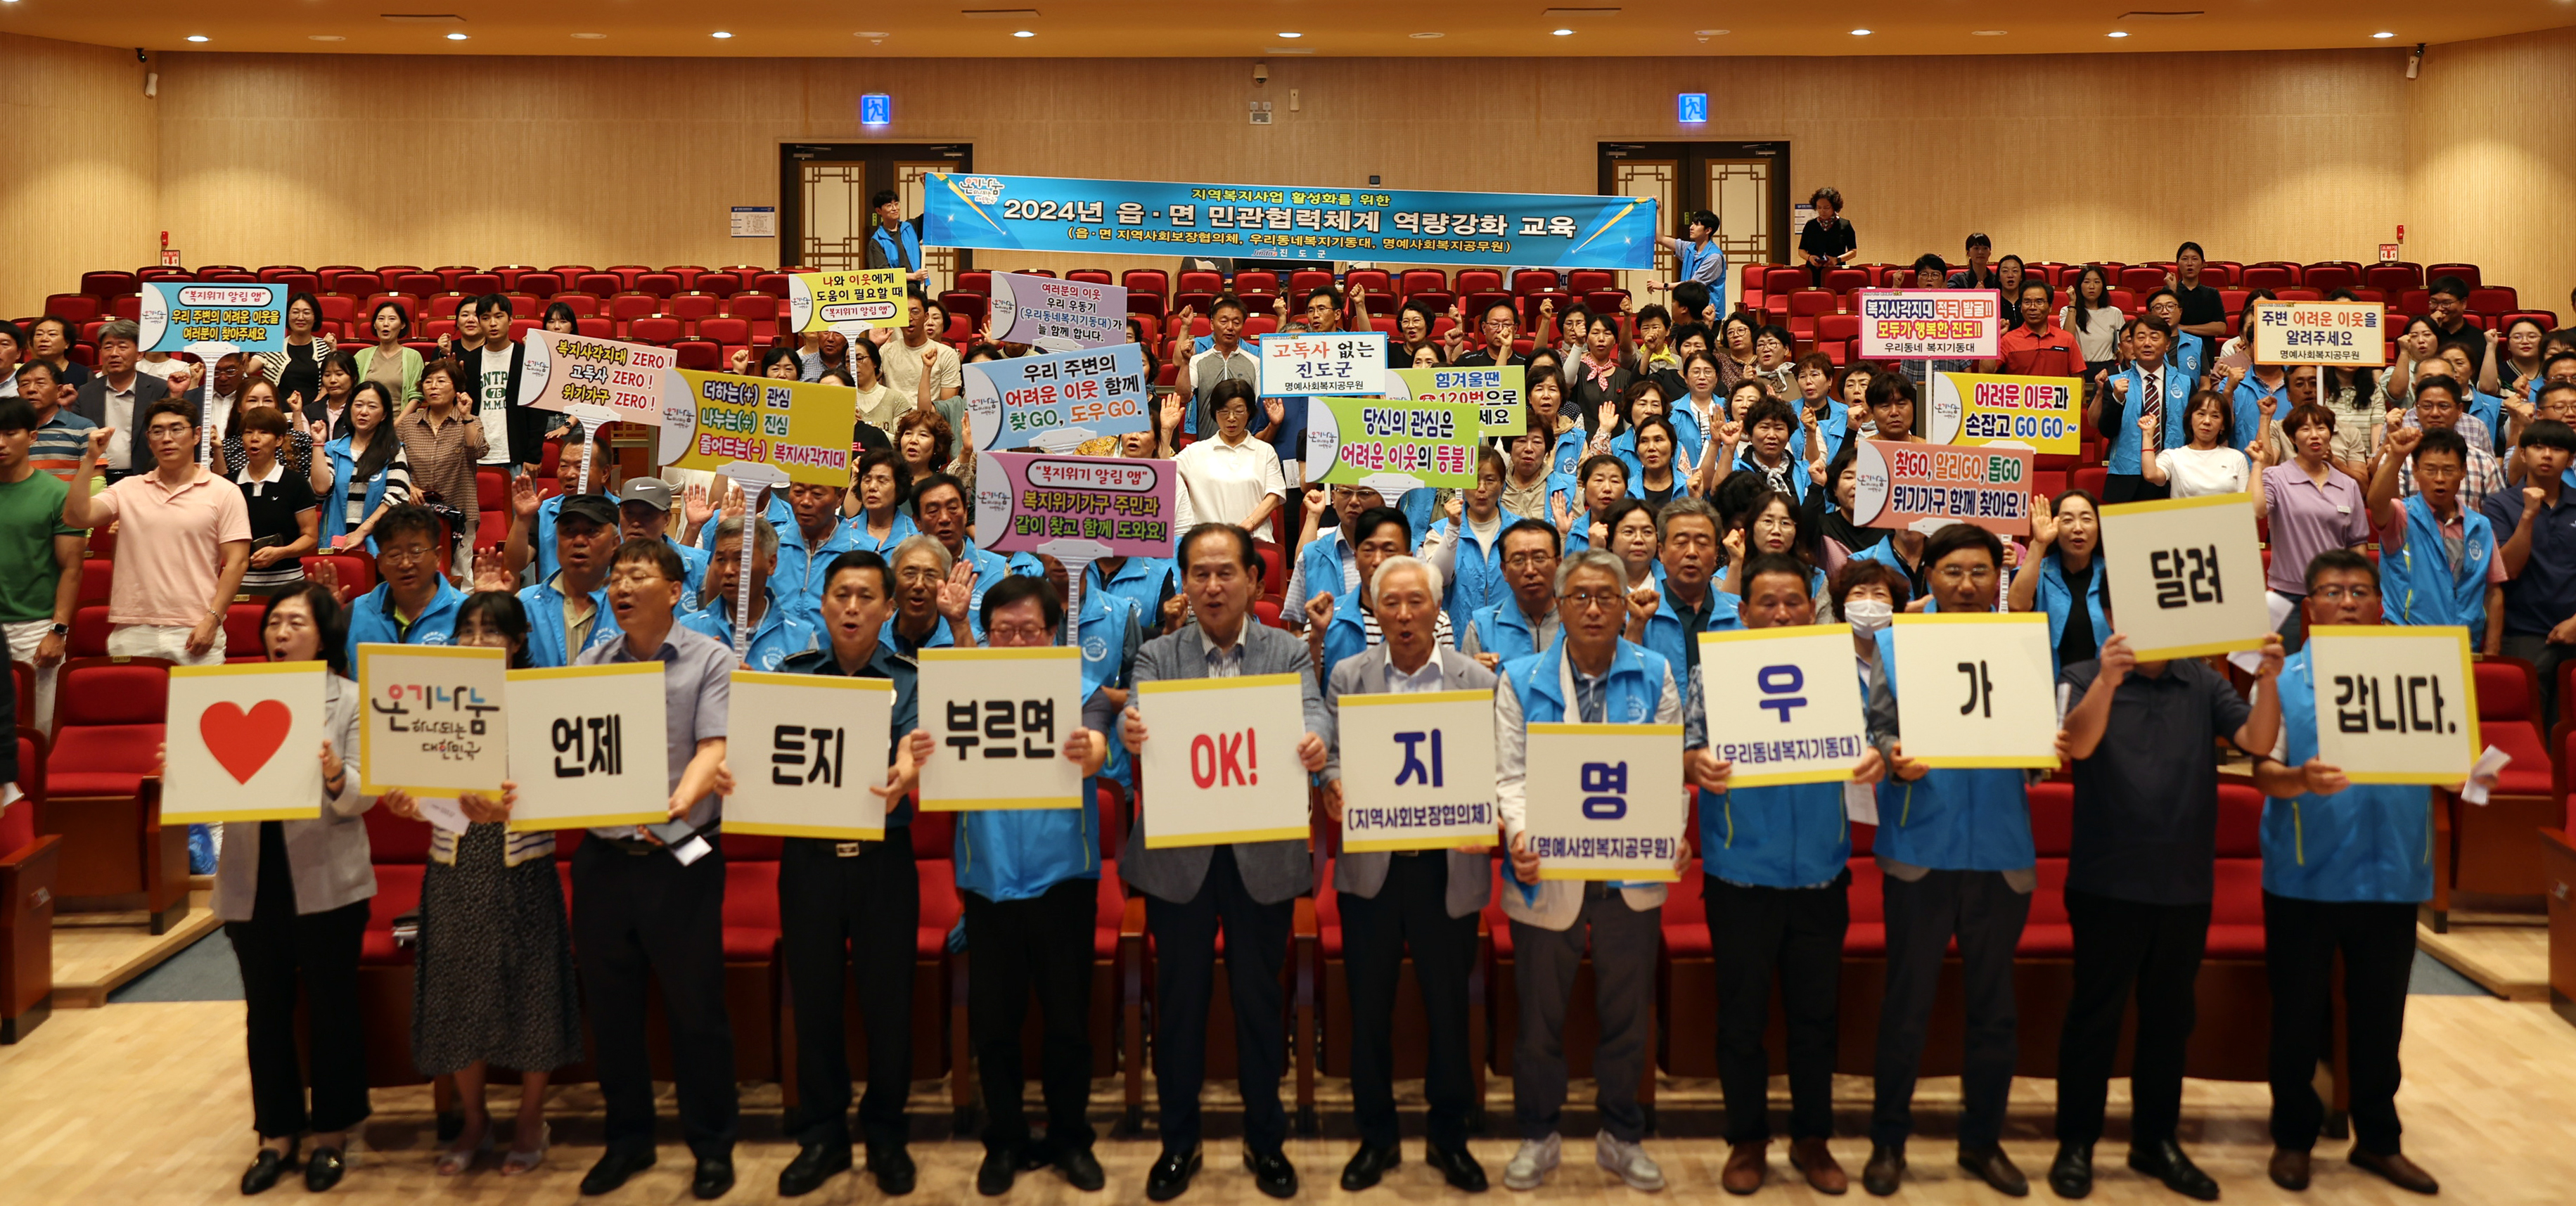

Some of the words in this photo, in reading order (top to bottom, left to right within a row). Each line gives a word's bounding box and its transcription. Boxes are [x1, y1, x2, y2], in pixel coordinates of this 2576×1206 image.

[960, 179, 1004, 195] 온기나눔
[1192, 188, 1283, 203] 지역복지사업
[1291, 191, 1352, 205] 활성화를
[1359, 194, 1391, 207] 위한
[1003, 199, 1103, 224] 2024년
[1209, 205, 1380, 233] 민관협력체계
[1393, 212, 1508, 236] 역량강화
[1518, 216, 1577, 238] 교육
[1116, 229, 1243, 245] 지역사회보장협의체,
[1250, 233, 1376, 249] 우리동네복지기동대,
[1383, 238, 1511, 253] 명예사회복지공무원)
[823, 276, 845, 287] 나와
[849, 273, 894, 286] 이웃에게
[1042, 283, 1079, 297] 여러분의
[1082, 288, 1101, 300] 이웃
[816, 290, 849, 302] 도움이
[854, 288, 887, 300] 필요할
[892, 287, 903, 297] 때
[1047, 297, 1065, 309] 우리
[1068, 302, 1096, 313] 우동기
[172, 310, 190, 323] 우리
[193, 309, 220, 324] 주변의
[222, 310, 250, 324] 어려운
[252, 310, 280, 324] 이웃을
[1020, 307, 1122, 331] (우리동네복지기동대)가
[1866, 300, 1934, 318] 복지사각지대
[1936, 300, 1960, 318] 적극
[1961, 300, 1993, 318] 발굴!!
[2262, 311, 2288, 326] 주변
[2293, 312, 2333, 327] 어려운
[2338, 312, 2377, 328] 이웃을
[183, 327, 219, 341] 여러분이
[222, 327, 267, 341] 찾아주세요
[1038, 323, 1046, 335] 늘
[1051, 325, 1069, 338] 함께
[1073, 328, 1104, 342] 합니다.
[1877, 320, 1912, 339] 모두가
[1913, 321, 1949, 340] 행복한
[1950, 321, 1982, 339] 진도!!
[2286, 330, 2353, 346] 알려주세요
[556, 339, 627, 366] 복지사각지대
[1272, 341, 1331, 359] 고독사
[1338, 340, 1375, 359] 없는
[1885, 343, 1923, 353] 우리동네
[1927, 342, 1975, 352] 복지기동대
[2280, 350, 2360, 360] 명예사회복지공무원
[570, 365, 608, 384] 고독사
[1023, 361, 1058, 383] 우리
[1064, 354, 1116, 378] 주변의
[1295, 361, 1352, 378] 진도군
[1435, 371, 1501, 388] 힘겨울땐
[490, 389, 501, 398] 76
[562, 383, 610, 405] 위기가구
[703, 380, 760, 407] 더하는(+)
[767, 387, 791, 409] 관심
[1006, 385, 1058, 408] 어려운
[1064, 380, 1098, 401] 이웃
[1104, 374, 1139, 396] 함께
[1285, 380, 1364, 391] 명예사회복지공무원
[1975, 383, 2020, 407] 어려운
[2024, 385, 2068, 410] 이웃과
[764, 415, 788, 435] 진심
[1363, 408, 1406, 436] 당신의
[1410, 410, 1454, 439] 관심은
[1966, 413, 2011, 437] 손잡고
[2015, 416, 2037, 437] GO
[2042, 417, 2063, 438] GO
[774, 443, 845, 469] 복지사각지대
[1341, 442, 1385, 470] 어려운
[1388, 444, 1431, 472] 이웃의
[1895, 450, 1931, 480] 찾GO,
[1935, 453, 1984, 483] 알리GO,
[1988, 456, 2021, 482] 돕GO
[1036, 466, 1090, 482] "복지위기
[1095, 469, 1122, 485] 알림
[1127, 470, 1148, 485] 앱"
[1023, 490, 1110, 515] 복지위기가구
[1115, 495, 1159, 516] 주민과
[1893, 486, 1946, 514] 위기가구
[1949, 488, 1976, 515] 함께
[1015, 515, 1044, 535] 같이
[1049, 516, 1078, 536] 찾고
[1083, 518, 1113, 539] 함께
[1117, 521, 1167, 541] 도와요!
[2149, 544, 2224, 609] 달려
[1757, 664, 1807, 722] 우
[1958, 660, 1994, 718] 가
[372, 684, 500, 735] 온기나눔
[2334, 674, 2456, 734] 갑니다.
[411, 718, 466, 739] 하나되는
[946, 698, 1055, 759] 부르면
[422, 739, 482, 760] 대한민국
[552, 714, 622, 778] 언제
[772, 724, 844, 788] 든지
[1191, 727, 1258, 789] OK!
[1716, 735, 1861, 765] (우리동네복지기동대)
[1393, 729, 1443, 788] 지
[1581, 761, 1627, 820] 명
[1348, 802, 1492, 830] (지역사회보장협의체)
[1530, 835, 1675, 862] (명예사회복지공무원)
